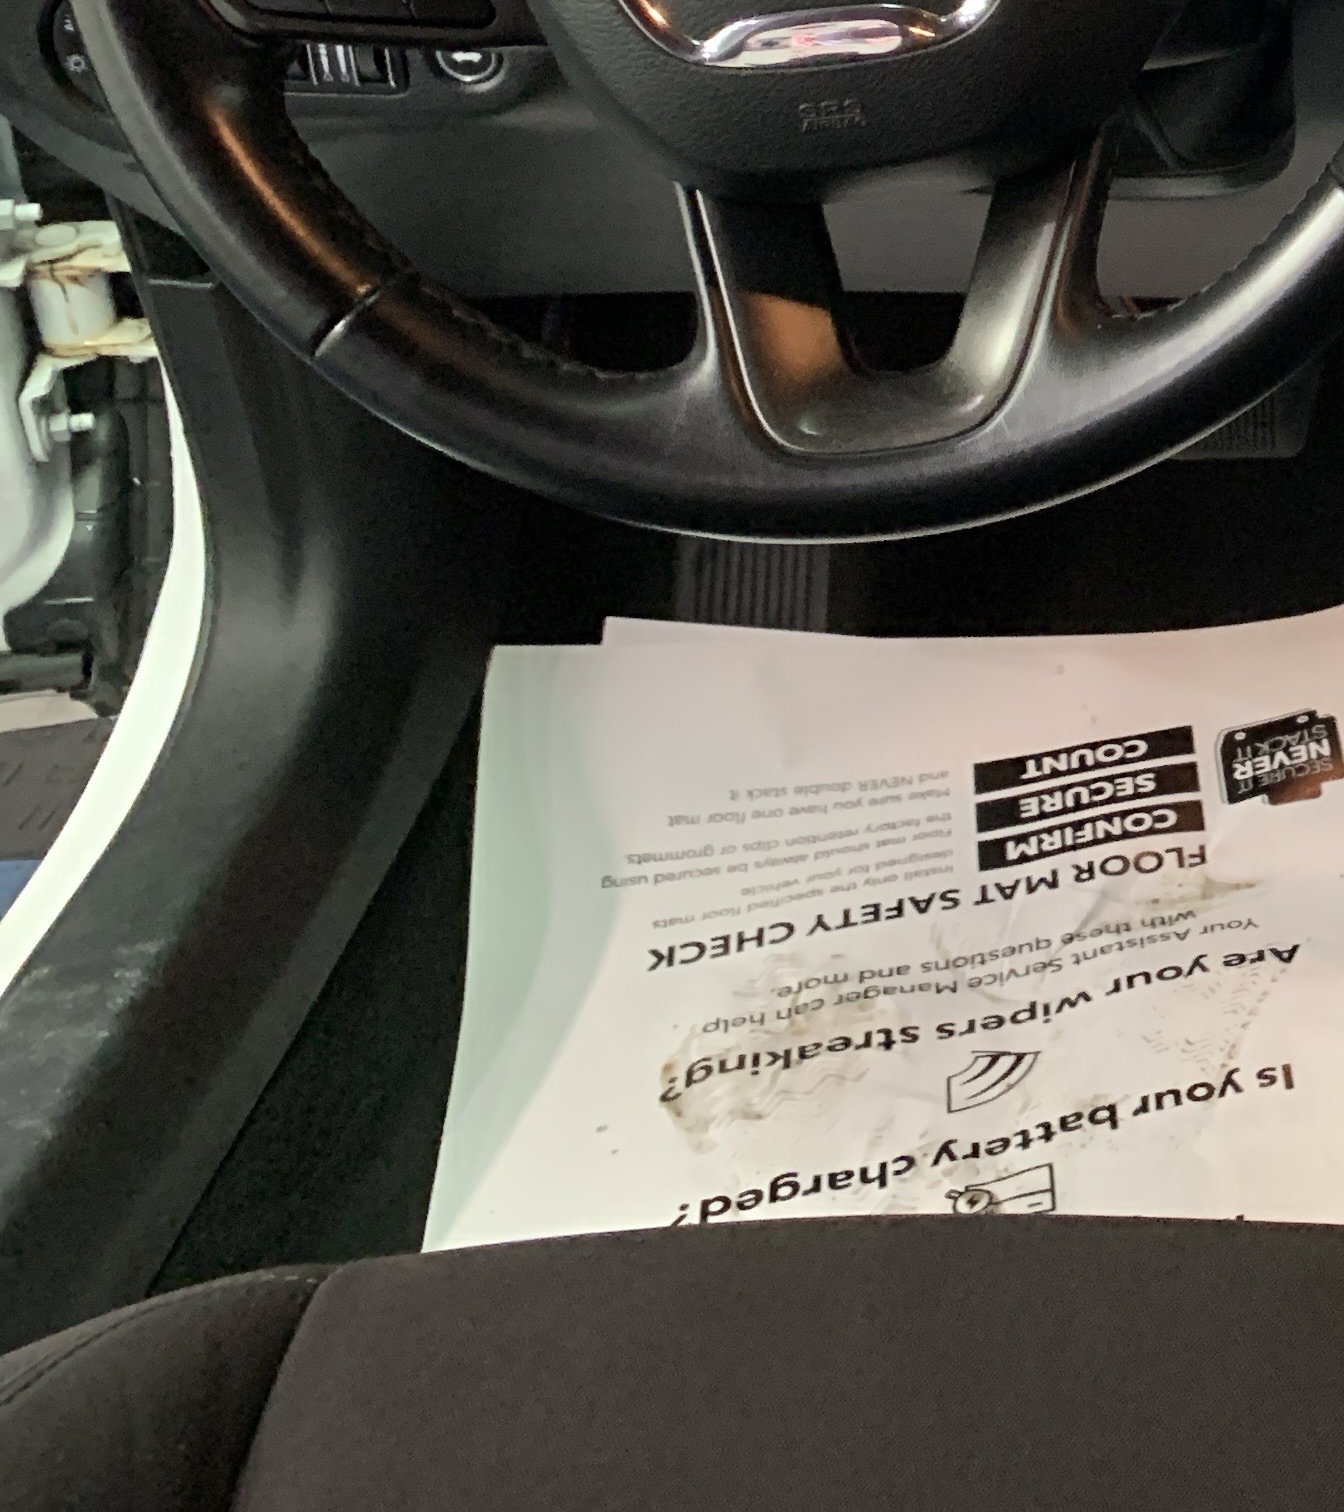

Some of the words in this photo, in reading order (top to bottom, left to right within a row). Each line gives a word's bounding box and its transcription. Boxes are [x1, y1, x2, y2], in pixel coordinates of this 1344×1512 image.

[1252, 723, 1329, 757] STACK
[1019, 738, 1149, 781] COUNT
[1231, 737, 1332, 781] NEVER
[1254, 756, 1333, 787] SECURE
[857, 774, 914, 793] NEVER
[1018, 771, 1157, 819] SECURE
[1003, 807, 1179, 862] CONFIRM
[1071, 843, 1208, 884] FLOOR
[599, 874, 649, 891] using
[972, 868, 1061, 907] MAT
[805, 888, 962, 937] SAFETY
[1141, 909, 1197, 931] with
[1198, 917, 1260, 936] Your
[647, 921, 796, 972] CHECK
[1059, 919, 1132, 947] these
[1069, 927, 1192, 967] Assistant
[858, 964, 912, 985] and
[919, 936, 1053, 976] questions
[967, 957, 1064, 992] Service
[1222, 943, 1301, 969] Are
[768, 971, 849, 998] more.
[831, 979, 959, 1007] Manager
[1104, 953, 1211, 998] your
[701, 1011, 766, 1035] help
[775, 997, 825, 1023] can
[934, 990, 1093, 1043] wipers
[658, 1024, 921, 1104] streaking?
[1255, 1063, 1296, 1091] Is
[1132, 1066, 1245, 1118] your
[930, 1102, 1120, 1168] battery
